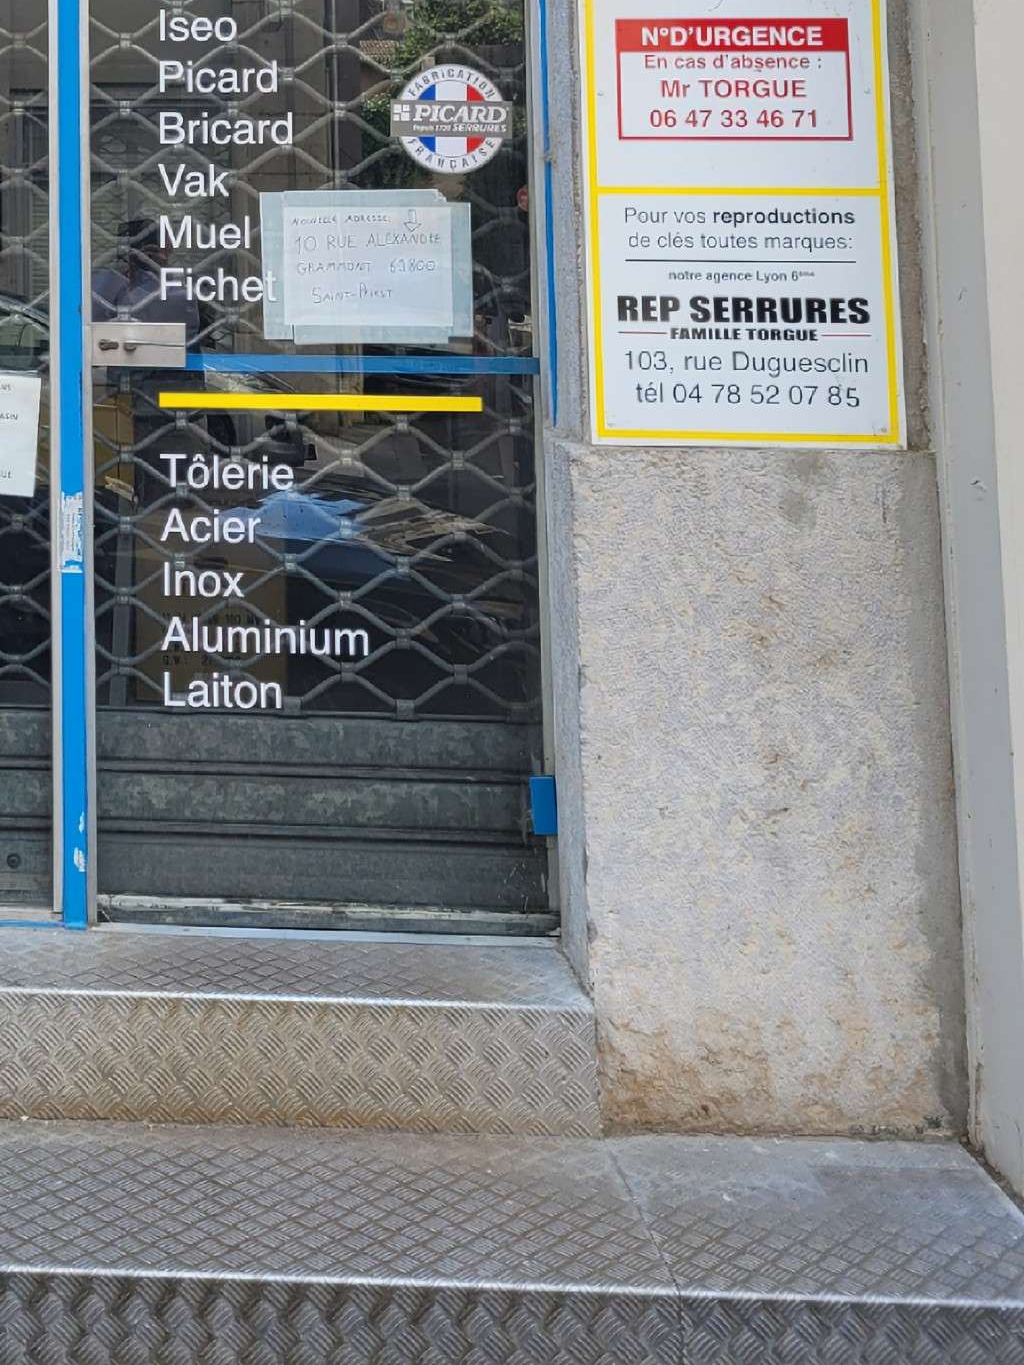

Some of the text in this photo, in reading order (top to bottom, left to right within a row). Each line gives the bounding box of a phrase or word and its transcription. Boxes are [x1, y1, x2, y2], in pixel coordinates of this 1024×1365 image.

[159, 10, 237, 42] Iseo
[645, 54, 810, 70] En cas d'absence
[159, 60, 278, 94] Picard
[408, 68, 496, 98] FABRICATION
[660, 79, 807, 98] Mr TORGUE
[159, 111, 293, 145] Bricard
[413, 105, 507, 123] PICARD
[453, 124, 507, 132] SERRURES
[649, 109, 818, 128] 06 47 33 46 71
[408, 139, 496, 171] FRANÇAISE
[158, 164, 229, 197] Vak
[159, 215, 251, 249] Muel
[624, 207, 855, 228] Pour vos reproductions
[295, 235, 317, 255] 10
[327, 235, 357, 249] RUE
[628, 232, 853, 253] de clés toutes marques:
[159, 268, 277, 302] Fichet
[668, 271, 702, 281] notre
[705, 272, 752, 283] agence
[755, 270, 787, 283] Lyon
[617, 295, 870, 324] REP SERRURES
[670, 328, 818, 342] FAMILLE TORGUE
[625, 351, 868, 378] 103, rue Duguesclin
[636, 383, 860, 408] tél 04 78 52 07 85
[160, 453, 295, 490] Tôlerie
[160, 508, 261, 544] Acier
[163, 562, 244, 598] Inox
[161, 616, 370, 656] Aluminium
[163, 671, 282, 709] Laiton
